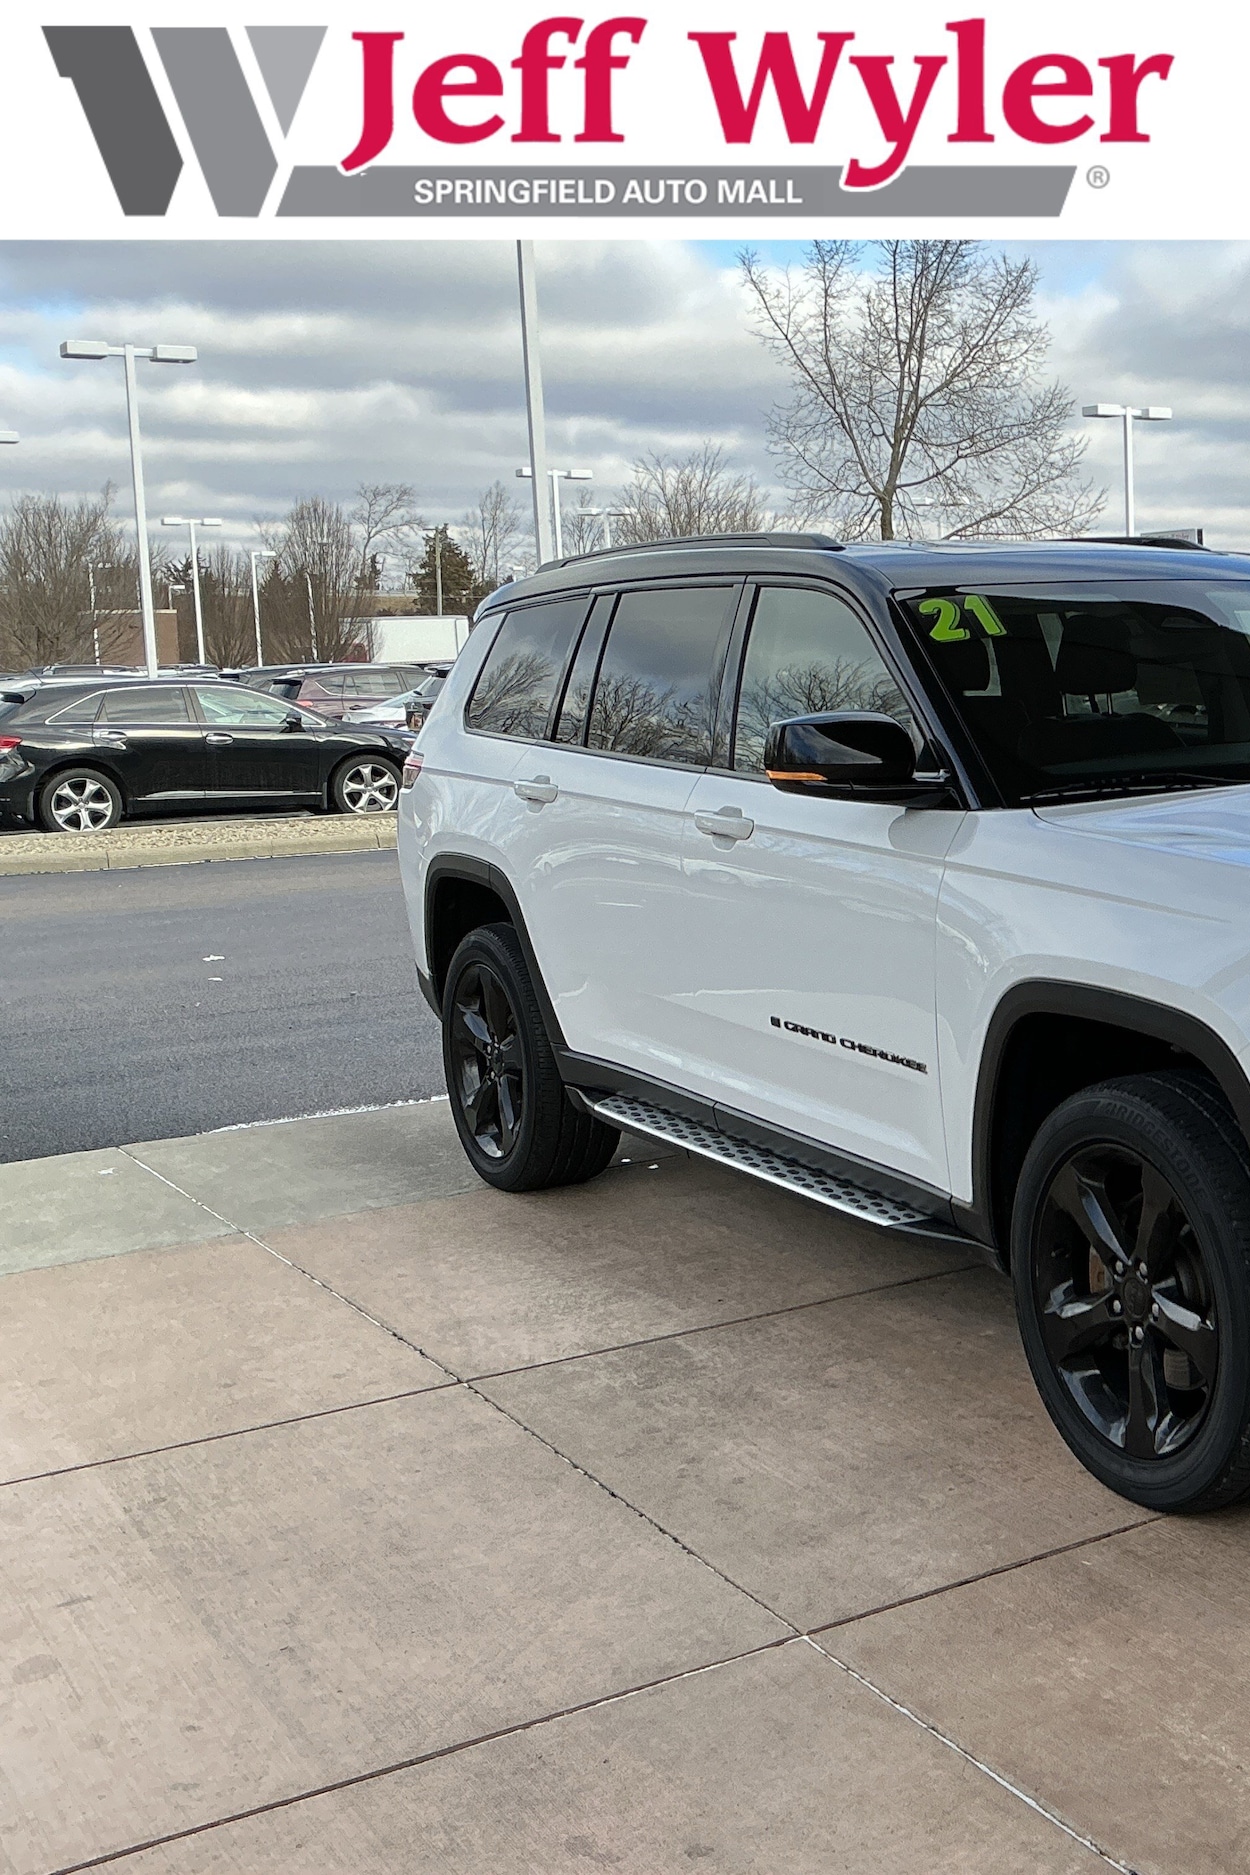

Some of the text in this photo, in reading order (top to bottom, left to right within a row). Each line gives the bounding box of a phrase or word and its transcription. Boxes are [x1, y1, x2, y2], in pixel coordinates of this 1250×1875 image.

[918, 594, 1008, 643] 21
[783, 1020, 928, 1074] GRAND CHEROKEE
